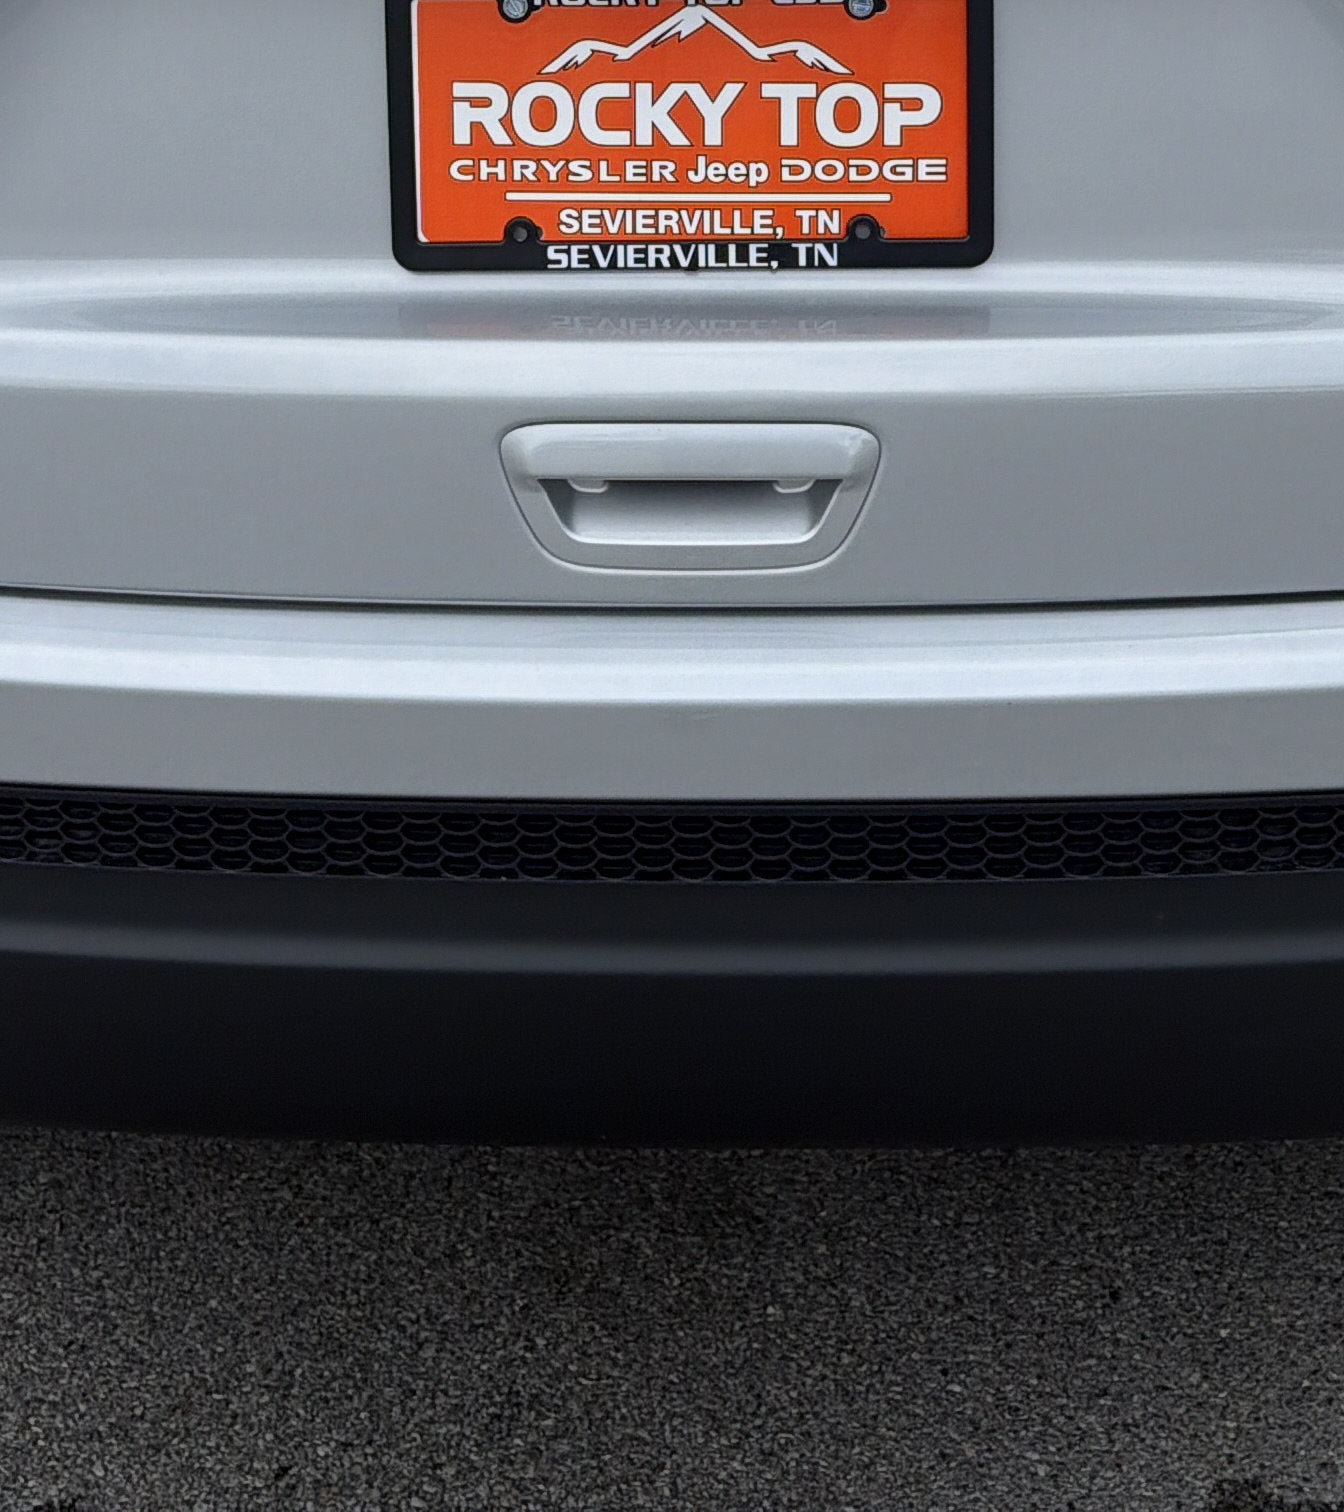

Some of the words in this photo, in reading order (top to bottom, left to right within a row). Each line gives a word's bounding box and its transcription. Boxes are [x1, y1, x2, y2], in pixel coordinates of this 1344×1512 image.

[450, 81, 745, 148] ROCKY
[760, 81, 944, 148] TOP
[449, 158, 678, 183] CHRYSLER
[686, 155, 770, 188] Jeep
[780, 158, 948, 183] DODGE
[558, 209, 785, 240] SEVIERVILLE,
[795, 209, 841, 236] TN
[546, 243, 779, 271] SEVIERVILLE,
[791, 242, 840, 268] TN
